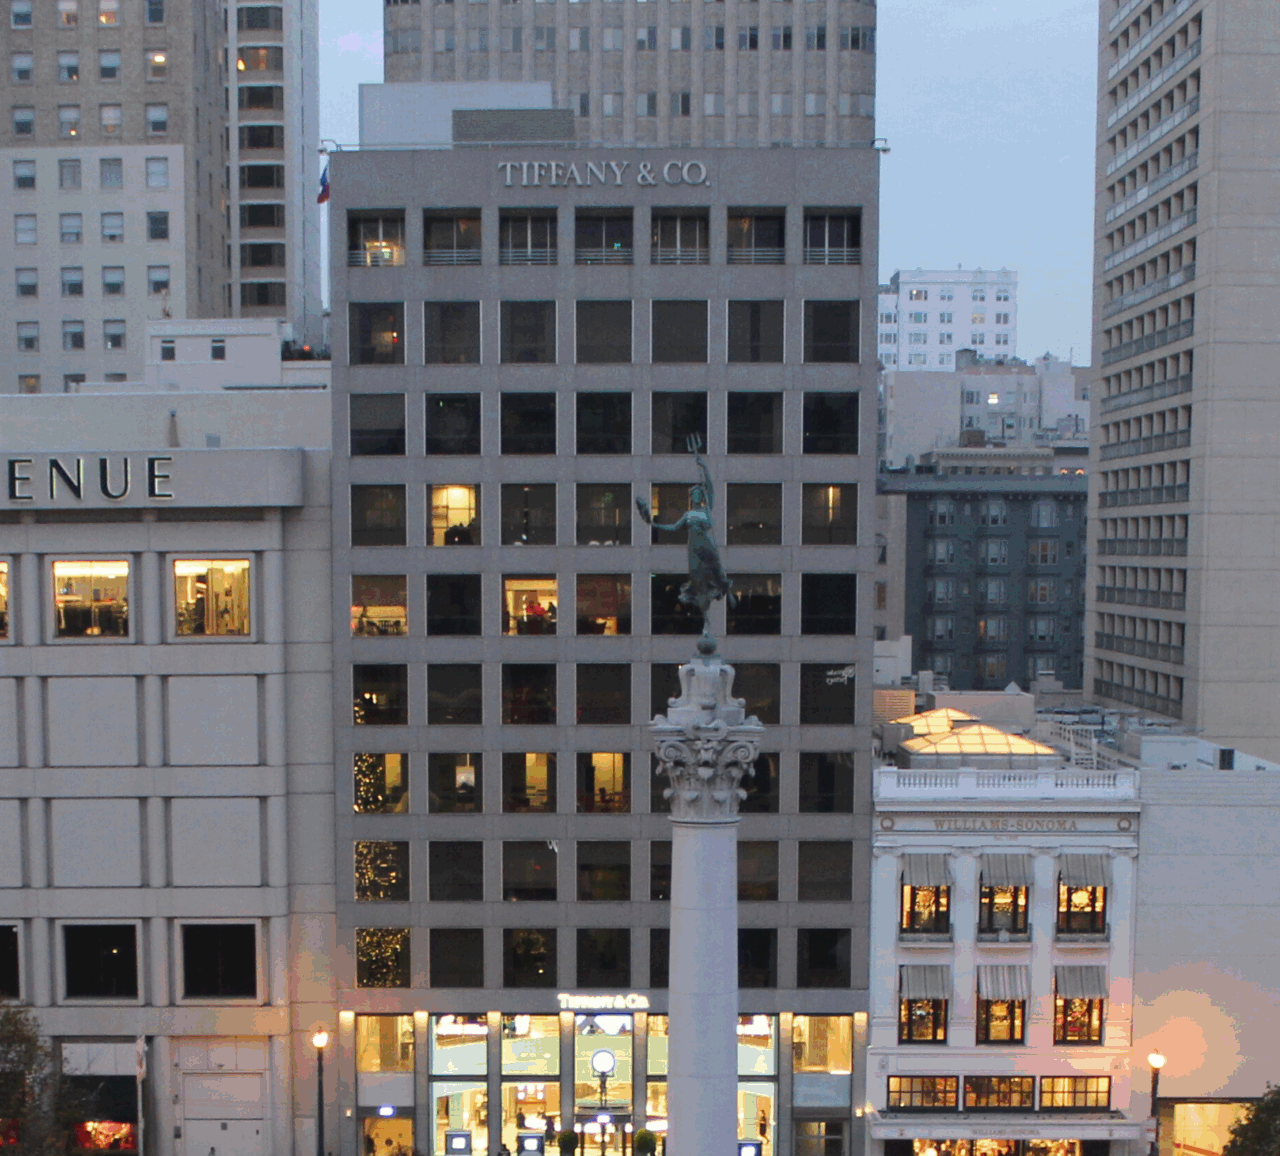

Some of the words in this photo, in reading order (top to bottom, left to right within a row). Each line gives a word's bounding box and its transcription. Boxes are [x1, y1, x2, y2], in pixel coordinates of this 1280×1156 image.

[497, 161, 630, 187] TIFFANY
[637, 161, 657, 187] &
[663, 160, 711, 187] CO.
[933, 818, 1079, 831] WILLIAMS-SONOMA
